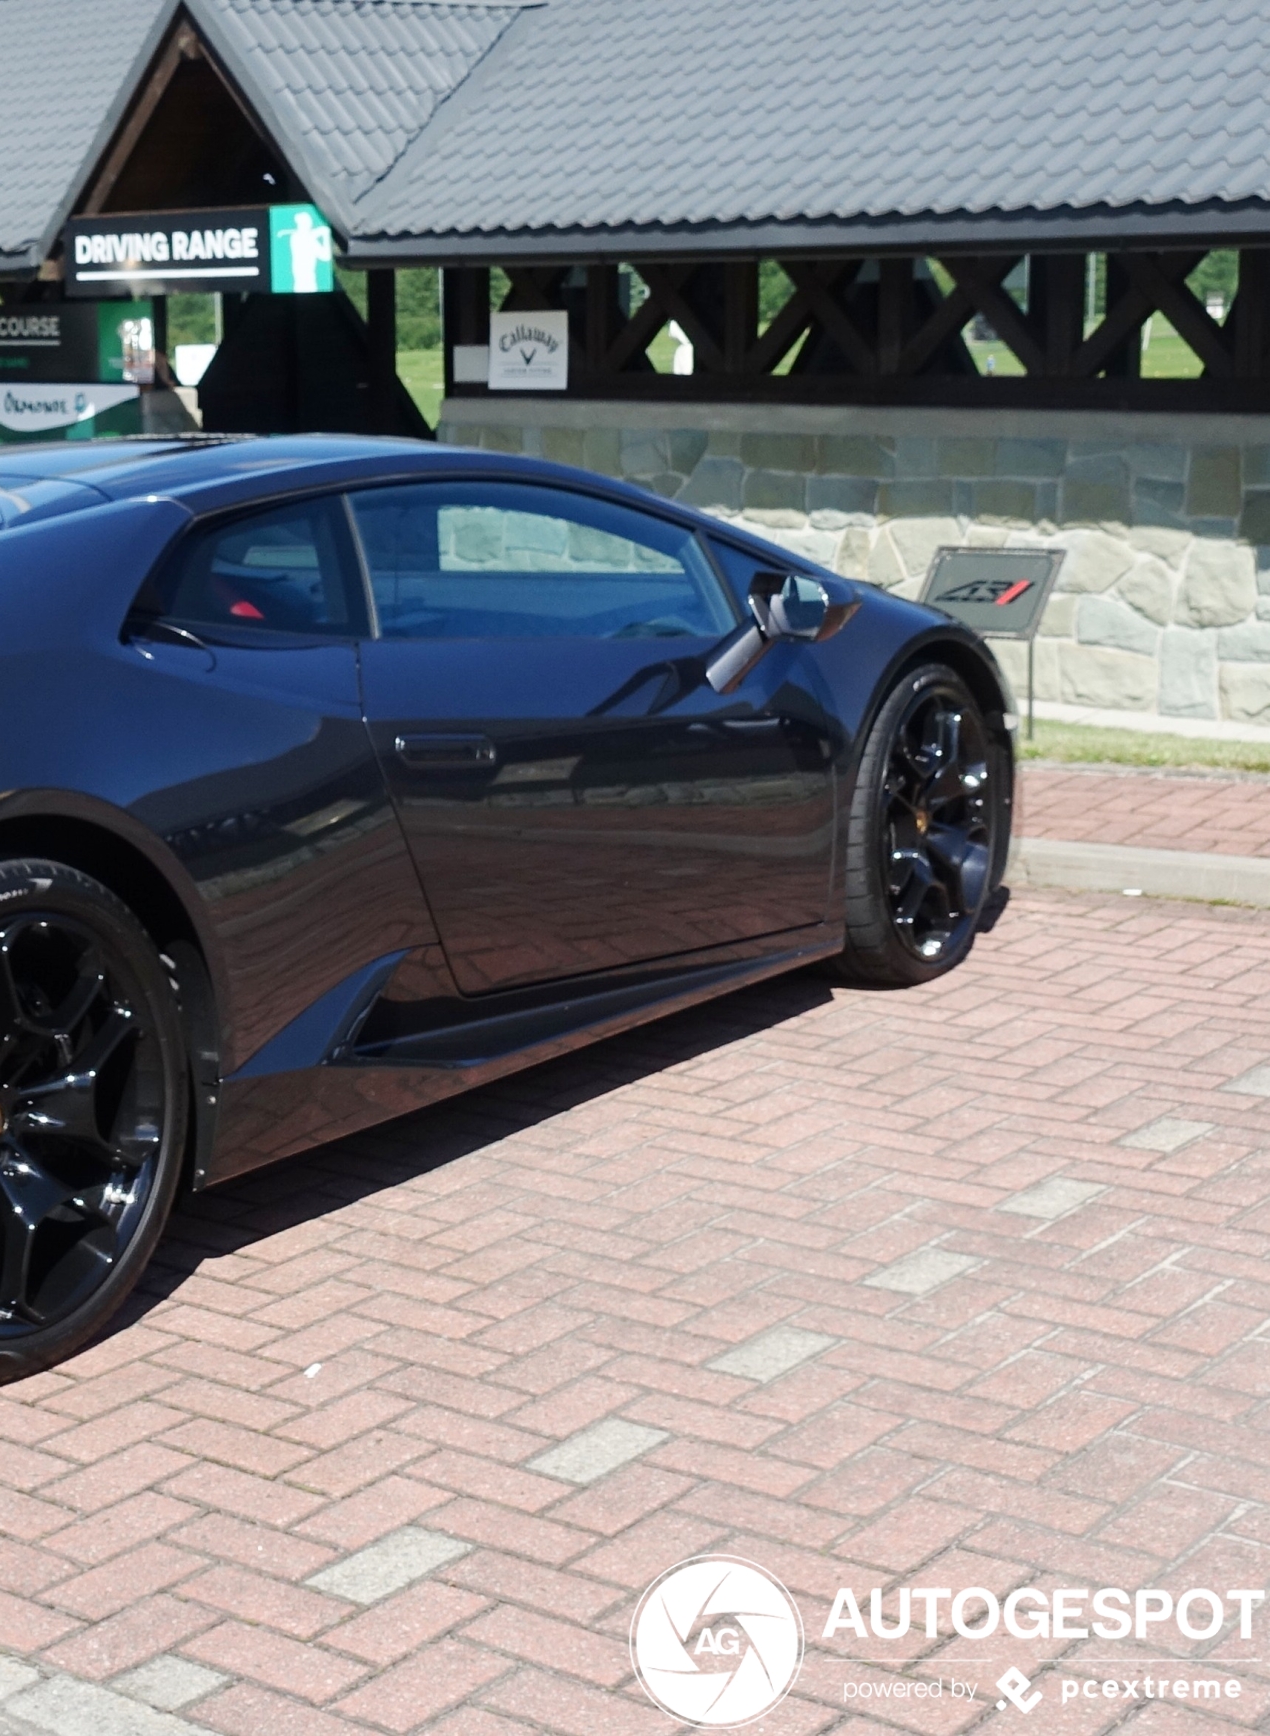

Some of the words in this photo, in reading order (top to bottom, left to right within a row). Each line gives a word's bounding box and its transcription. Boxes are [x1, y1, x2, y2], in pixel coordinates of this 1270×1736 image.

[75, 232, 169, 264] DRIVING
[171, 227, 259, 260] RANGE
[498, 324, 560, 354] Callaway
